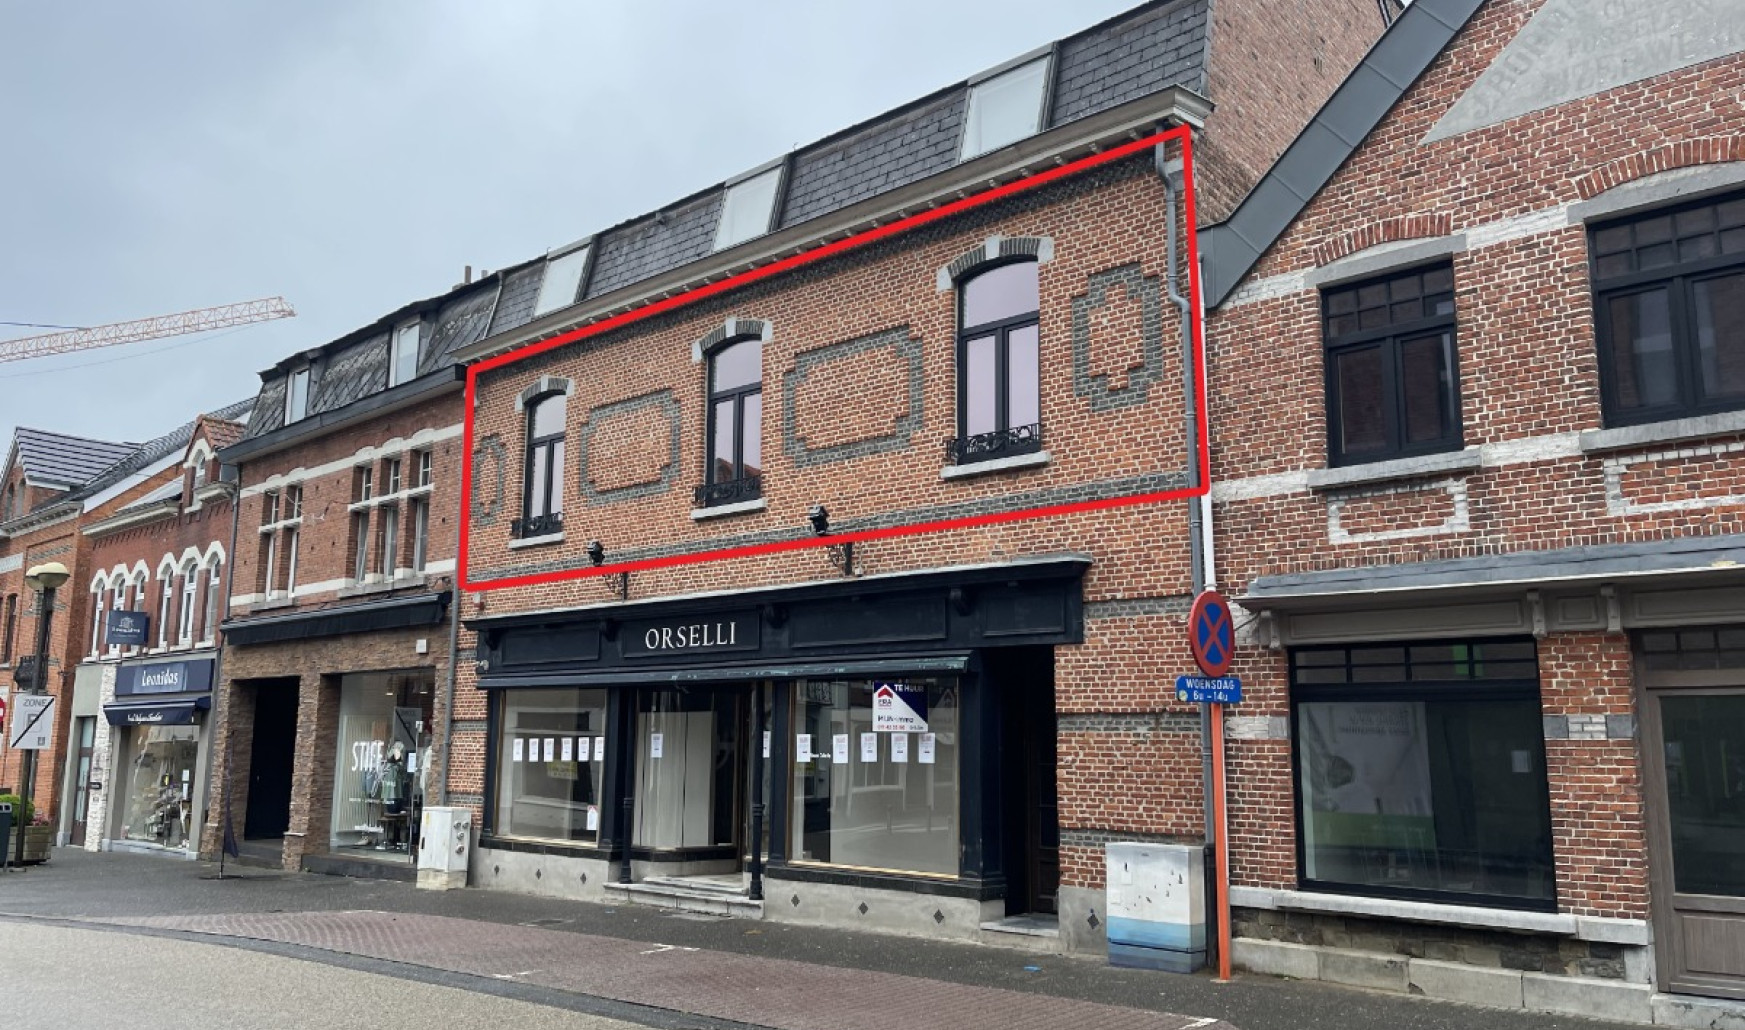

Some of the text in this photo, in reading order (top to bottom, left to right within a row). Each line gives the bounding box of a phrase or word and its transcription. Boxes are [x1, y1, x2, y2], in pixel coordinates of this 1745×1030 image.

[645, 621, 736, 650] ORSELLI
[141, 667, 178, 687] Leonidas
[894, 684, 903, 692] TE
[1186, 679, 1235, 690] WOENSDAG
[23, 698, 47, 707] ZONE
